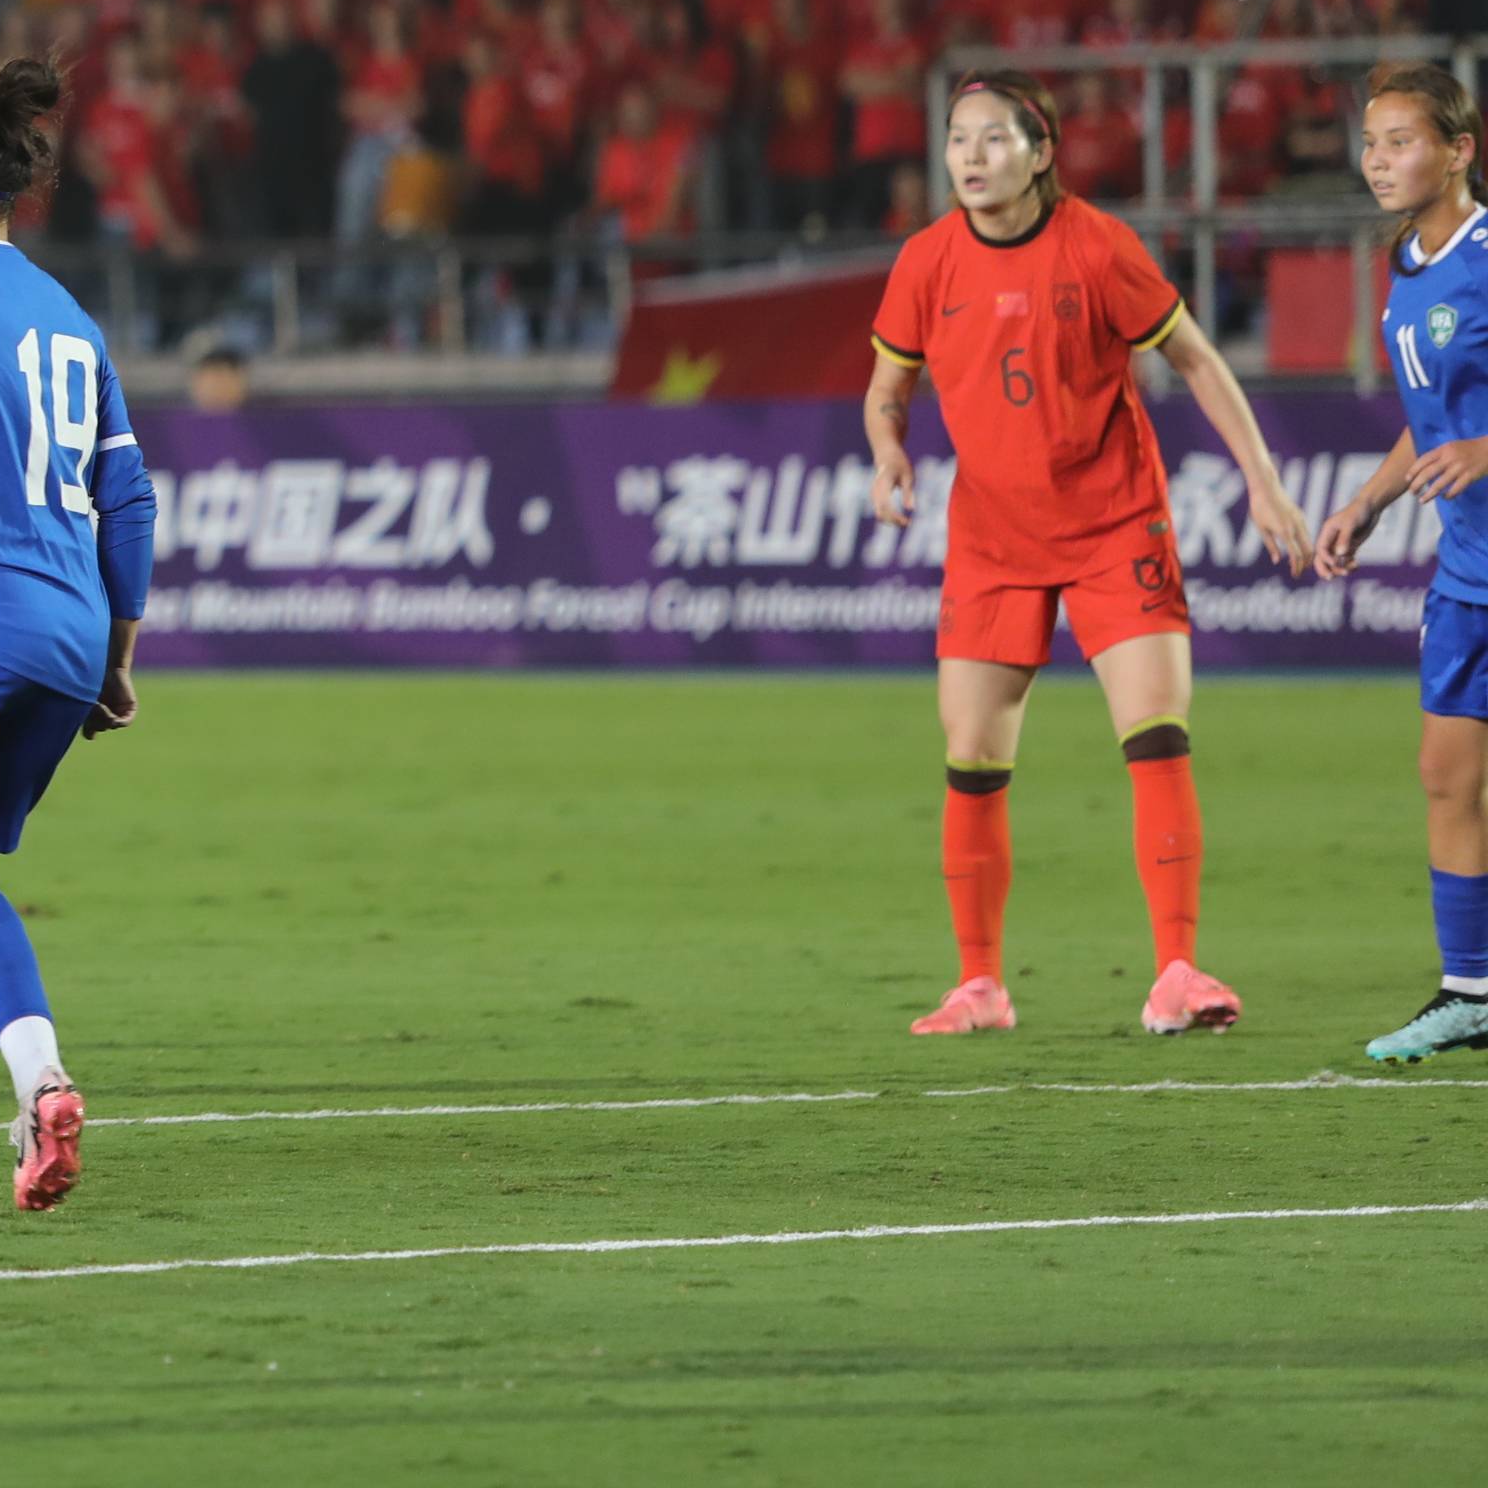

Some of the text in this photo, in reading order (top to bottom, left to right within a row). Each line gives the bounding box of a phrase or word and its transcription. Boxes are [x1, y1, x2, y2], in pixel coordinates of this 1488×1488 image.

[1000, 348, 1035, 407] 6
[1396, 323, 1431, 389] 11
[17, 328, 98, 515] 19
